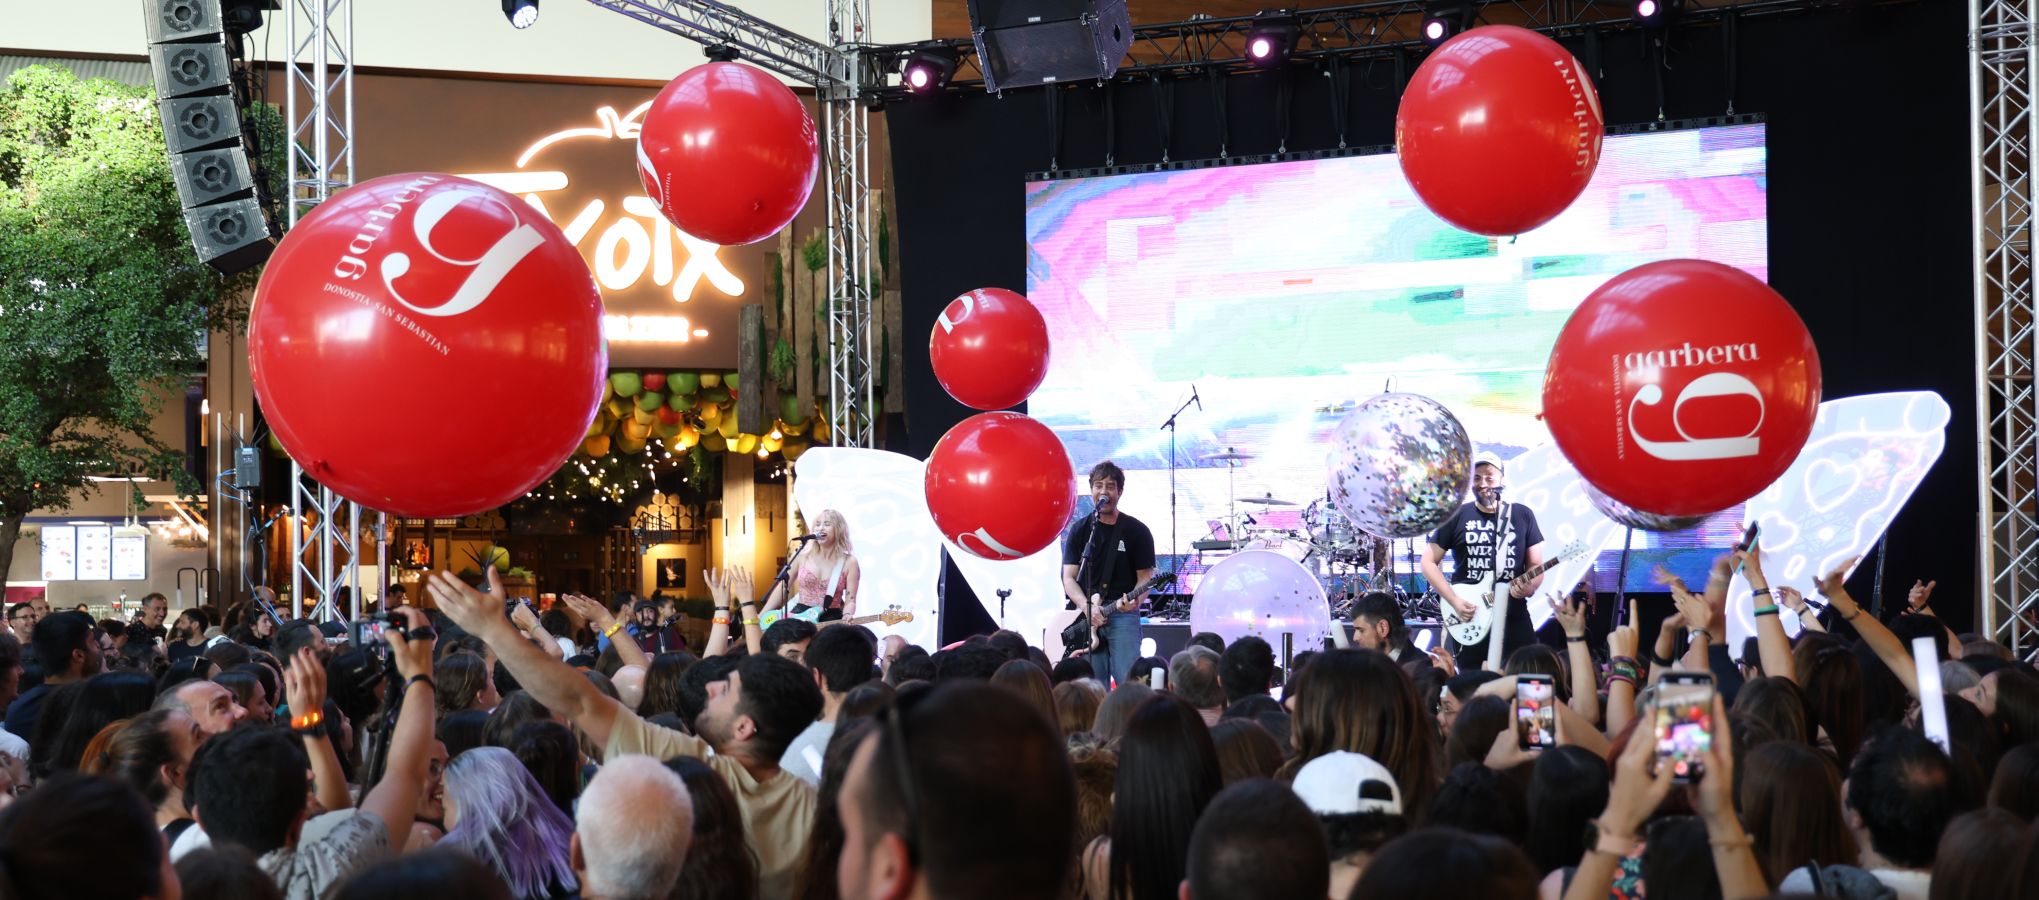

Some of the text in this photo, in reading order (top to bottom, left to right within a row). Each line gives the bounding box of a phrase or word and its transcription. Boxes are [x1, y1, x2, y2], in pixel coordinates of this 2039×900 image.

[335, 174, 445, 281] garbera
[322, 282, 452, 357] DONOSTIA SAN SEBASTIAN
[1624, 342, 1761, 377] garbera
